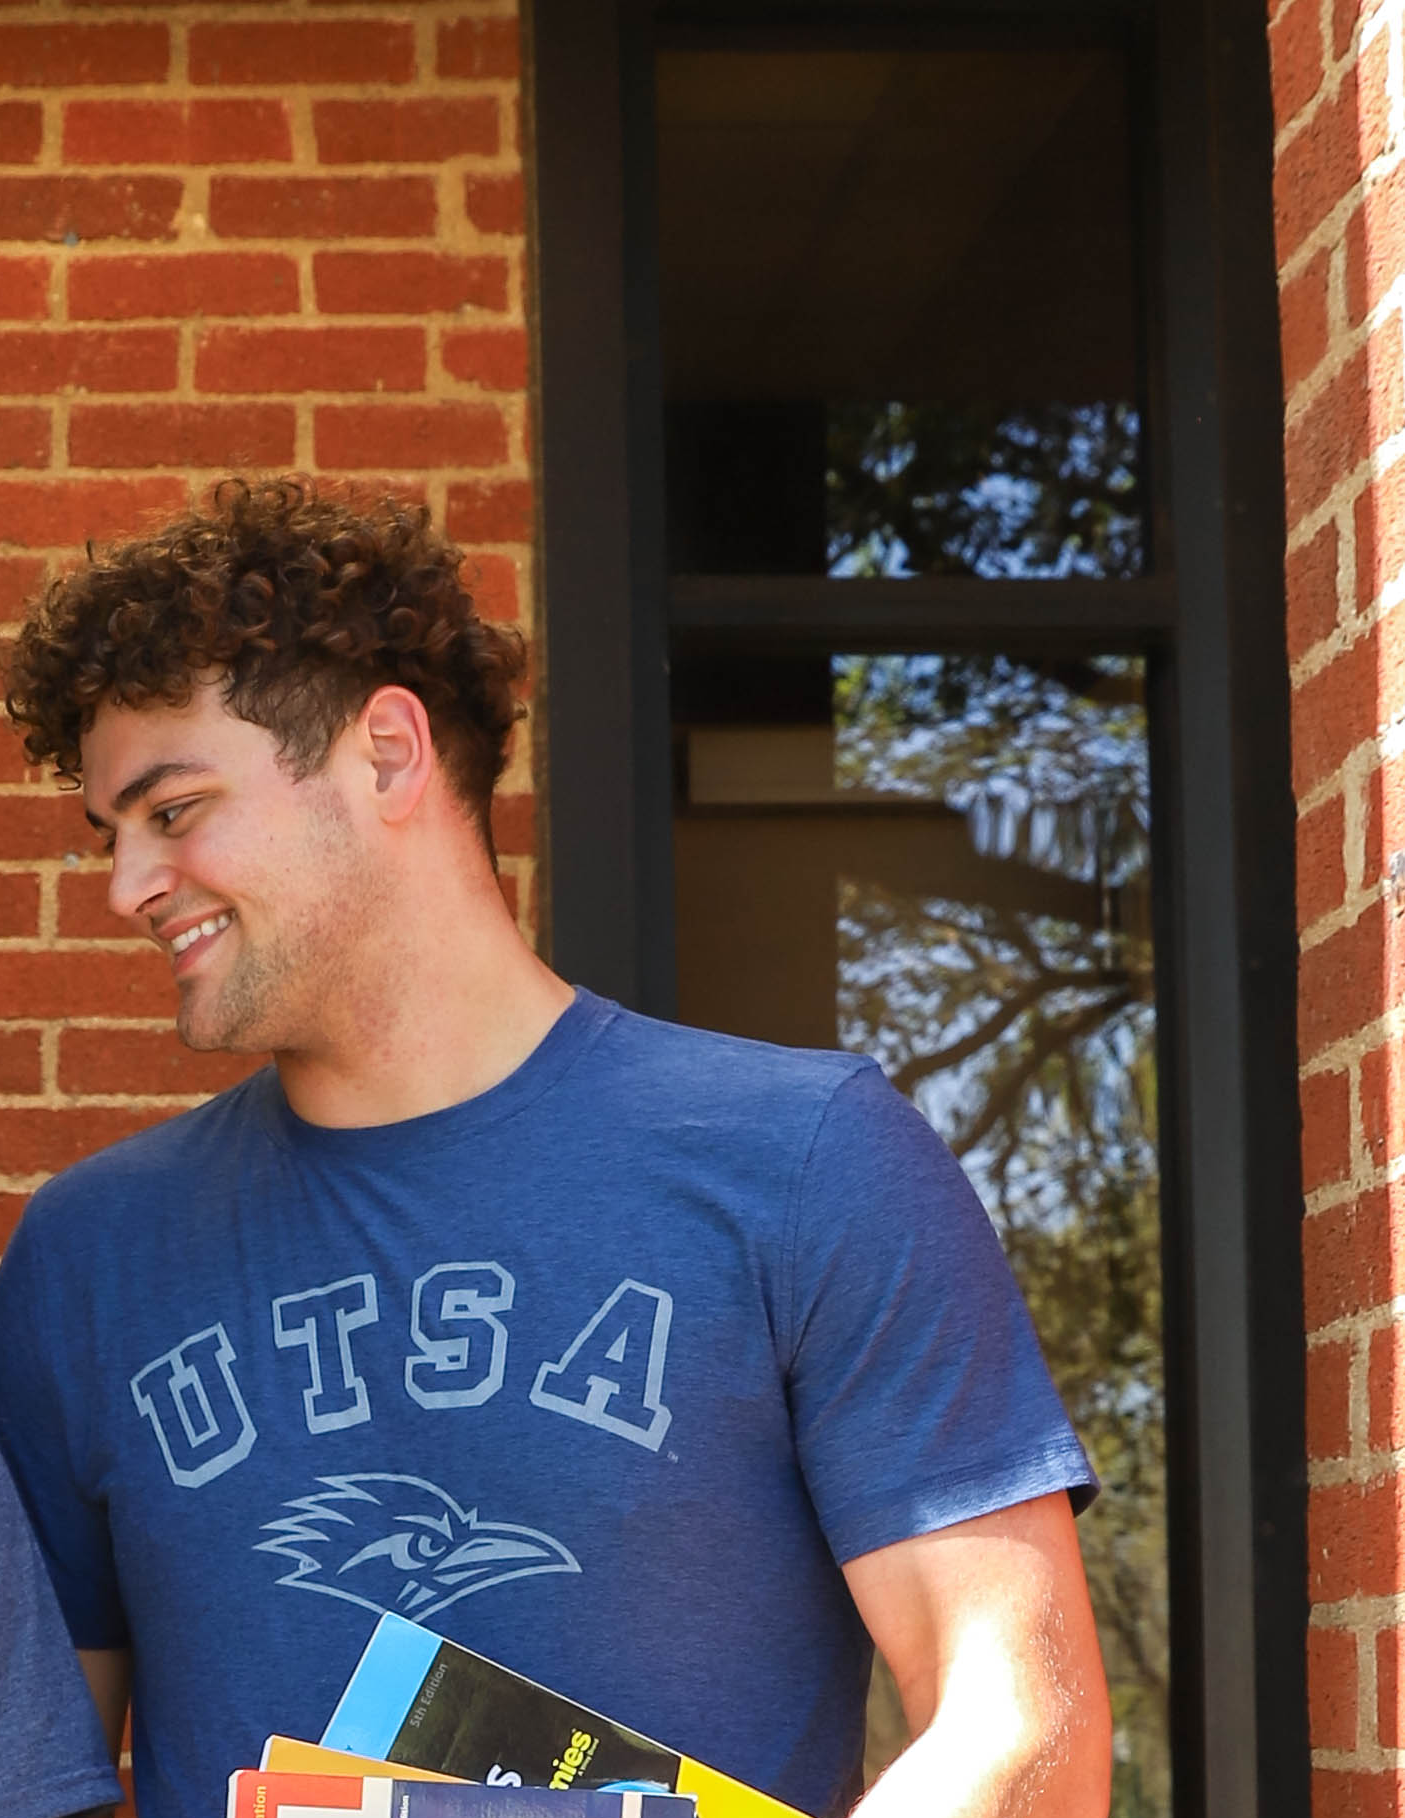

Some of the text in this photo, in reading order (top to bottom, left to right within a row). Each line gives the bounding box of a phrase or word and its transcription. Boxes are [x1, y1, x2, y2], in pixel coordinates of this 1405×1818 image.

[129, 1261, 673, 1488] UTSA
[410, 1663, 448, 1728] 5th Edition
